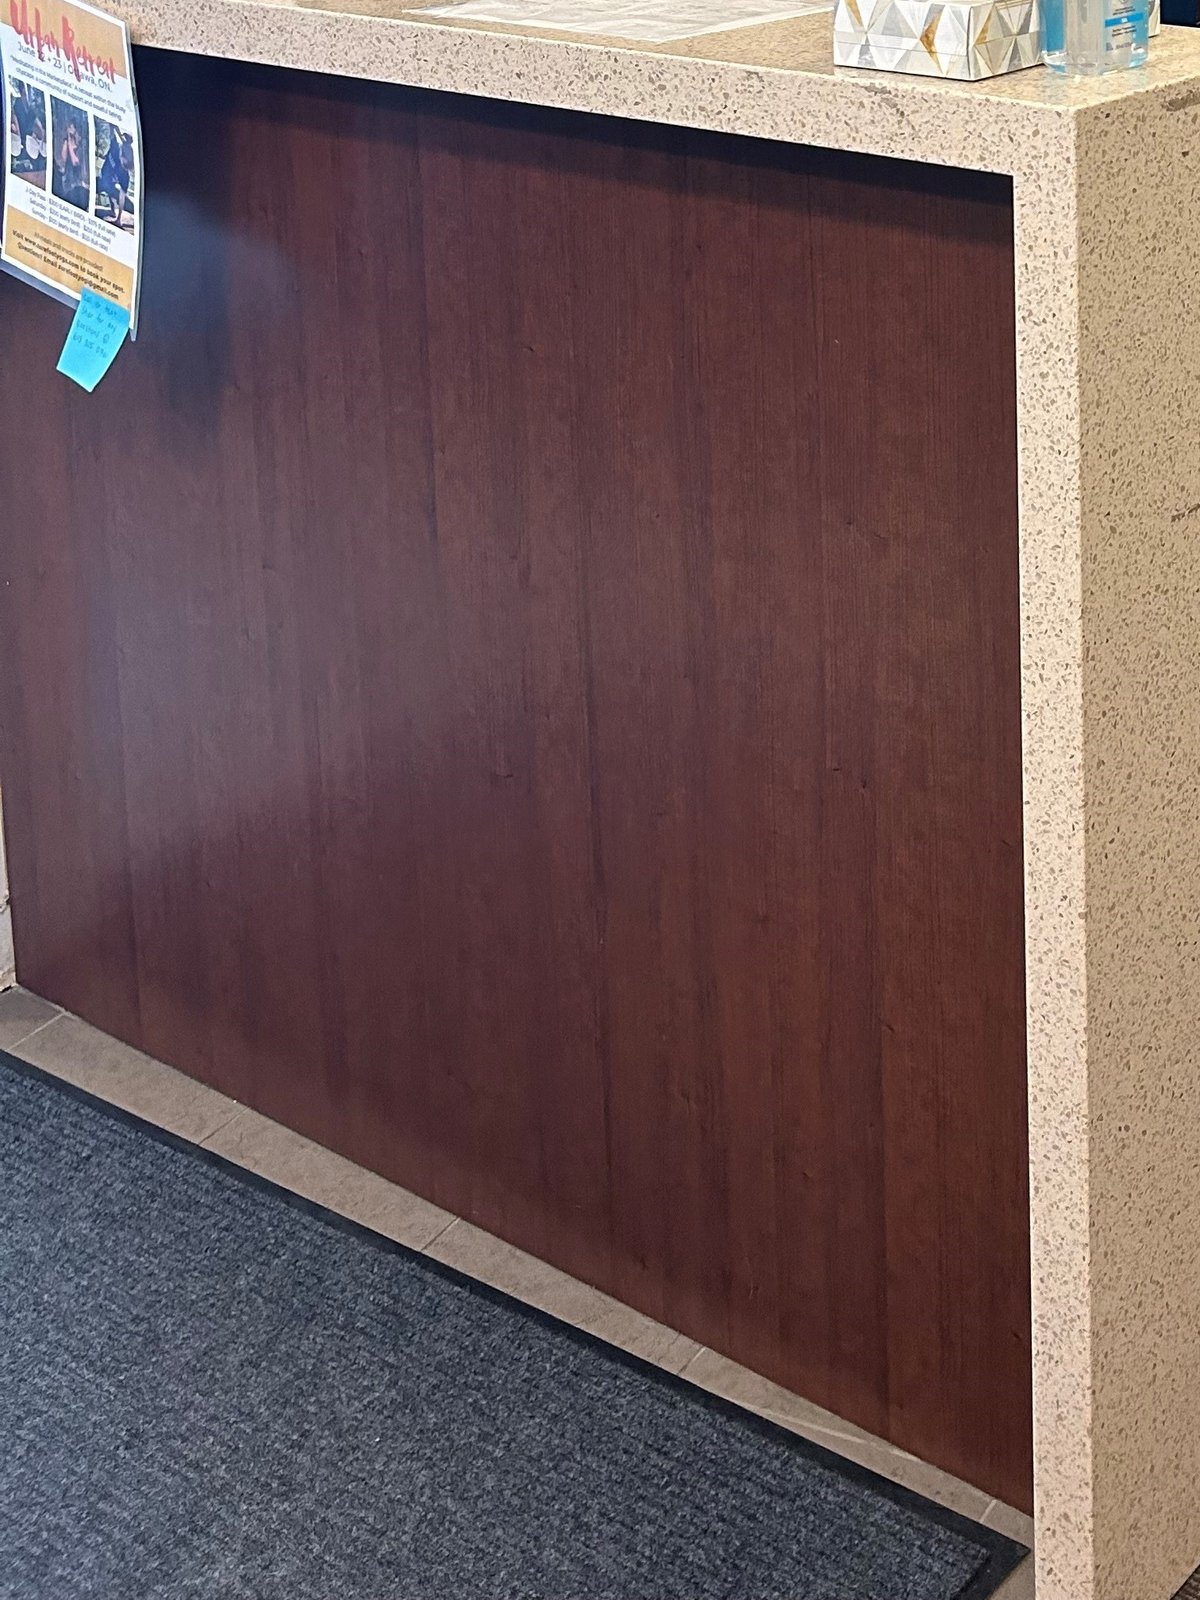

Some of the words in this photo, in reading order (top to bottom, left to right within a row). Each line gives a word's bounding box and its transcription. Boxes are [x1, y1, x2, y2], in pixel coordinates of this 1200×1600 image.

[18, 41, 36, 57] June
[53, 56, 62, 69] 23
[67, 64, 97, 87] Oawa,
[62, 15, 116, 85] Retreat
